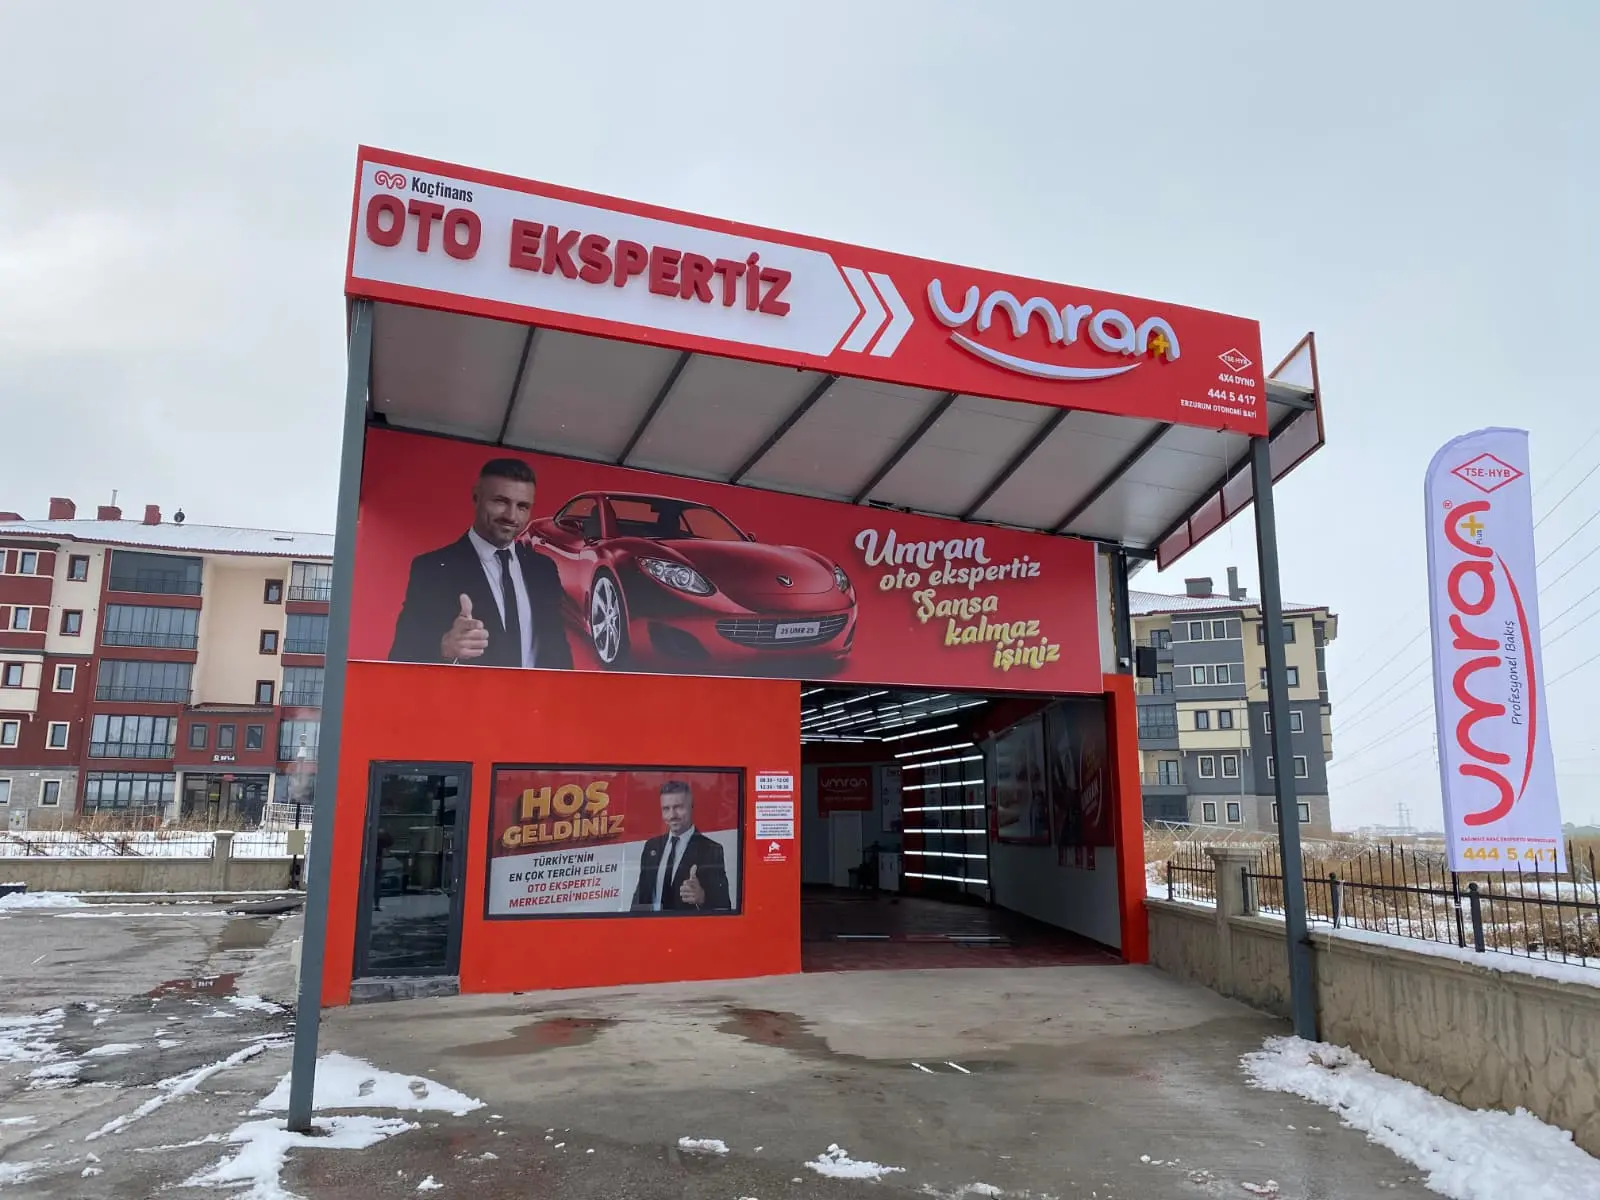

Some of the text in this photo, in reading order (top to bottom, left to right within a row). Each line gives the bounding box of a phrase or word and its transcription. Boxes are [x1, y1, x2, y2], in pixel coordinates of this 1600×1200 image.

[411, 176, 473, 203] Koçfinans
[366, 193, 792, 317] OTO EKSPERTİZ
[927, 278, 1180, 363] umran
[1207, 388, 1256, 406] 444 5 417
[1218, 373, 1255, 388] 4X4 DYNO
[1464, 467, 1511, 478] TSE-HYB
[855, 529, 992, 569] Umran
[879, 555, 1041, 592] oto ekspertiz
[913, 589, 999, 623] Şansa
[944, 615, 1041, 647] kalmaz
[993, 637, 1061, 671] işiniz
[1443, 500, 1515, 826] umran
[1503, 620, 1523, 725] Profesyonel Bakış
[521, 781, 610, 819] HOŞ
[503, 811, 625, 846] GELDİNİZ
[533, 853, 594, 867] TÜRKİYE'NİN
[1463, 847, 1556, 862] 444 5 417
[509, 863, 618, 883] EN ÇOK TERCİH EDİLEN
[527, 876, 602, 893] OTO EKSPERTİZ
[509, 887, 620, 908] MERKEZLERİ'NDESİNİZ
